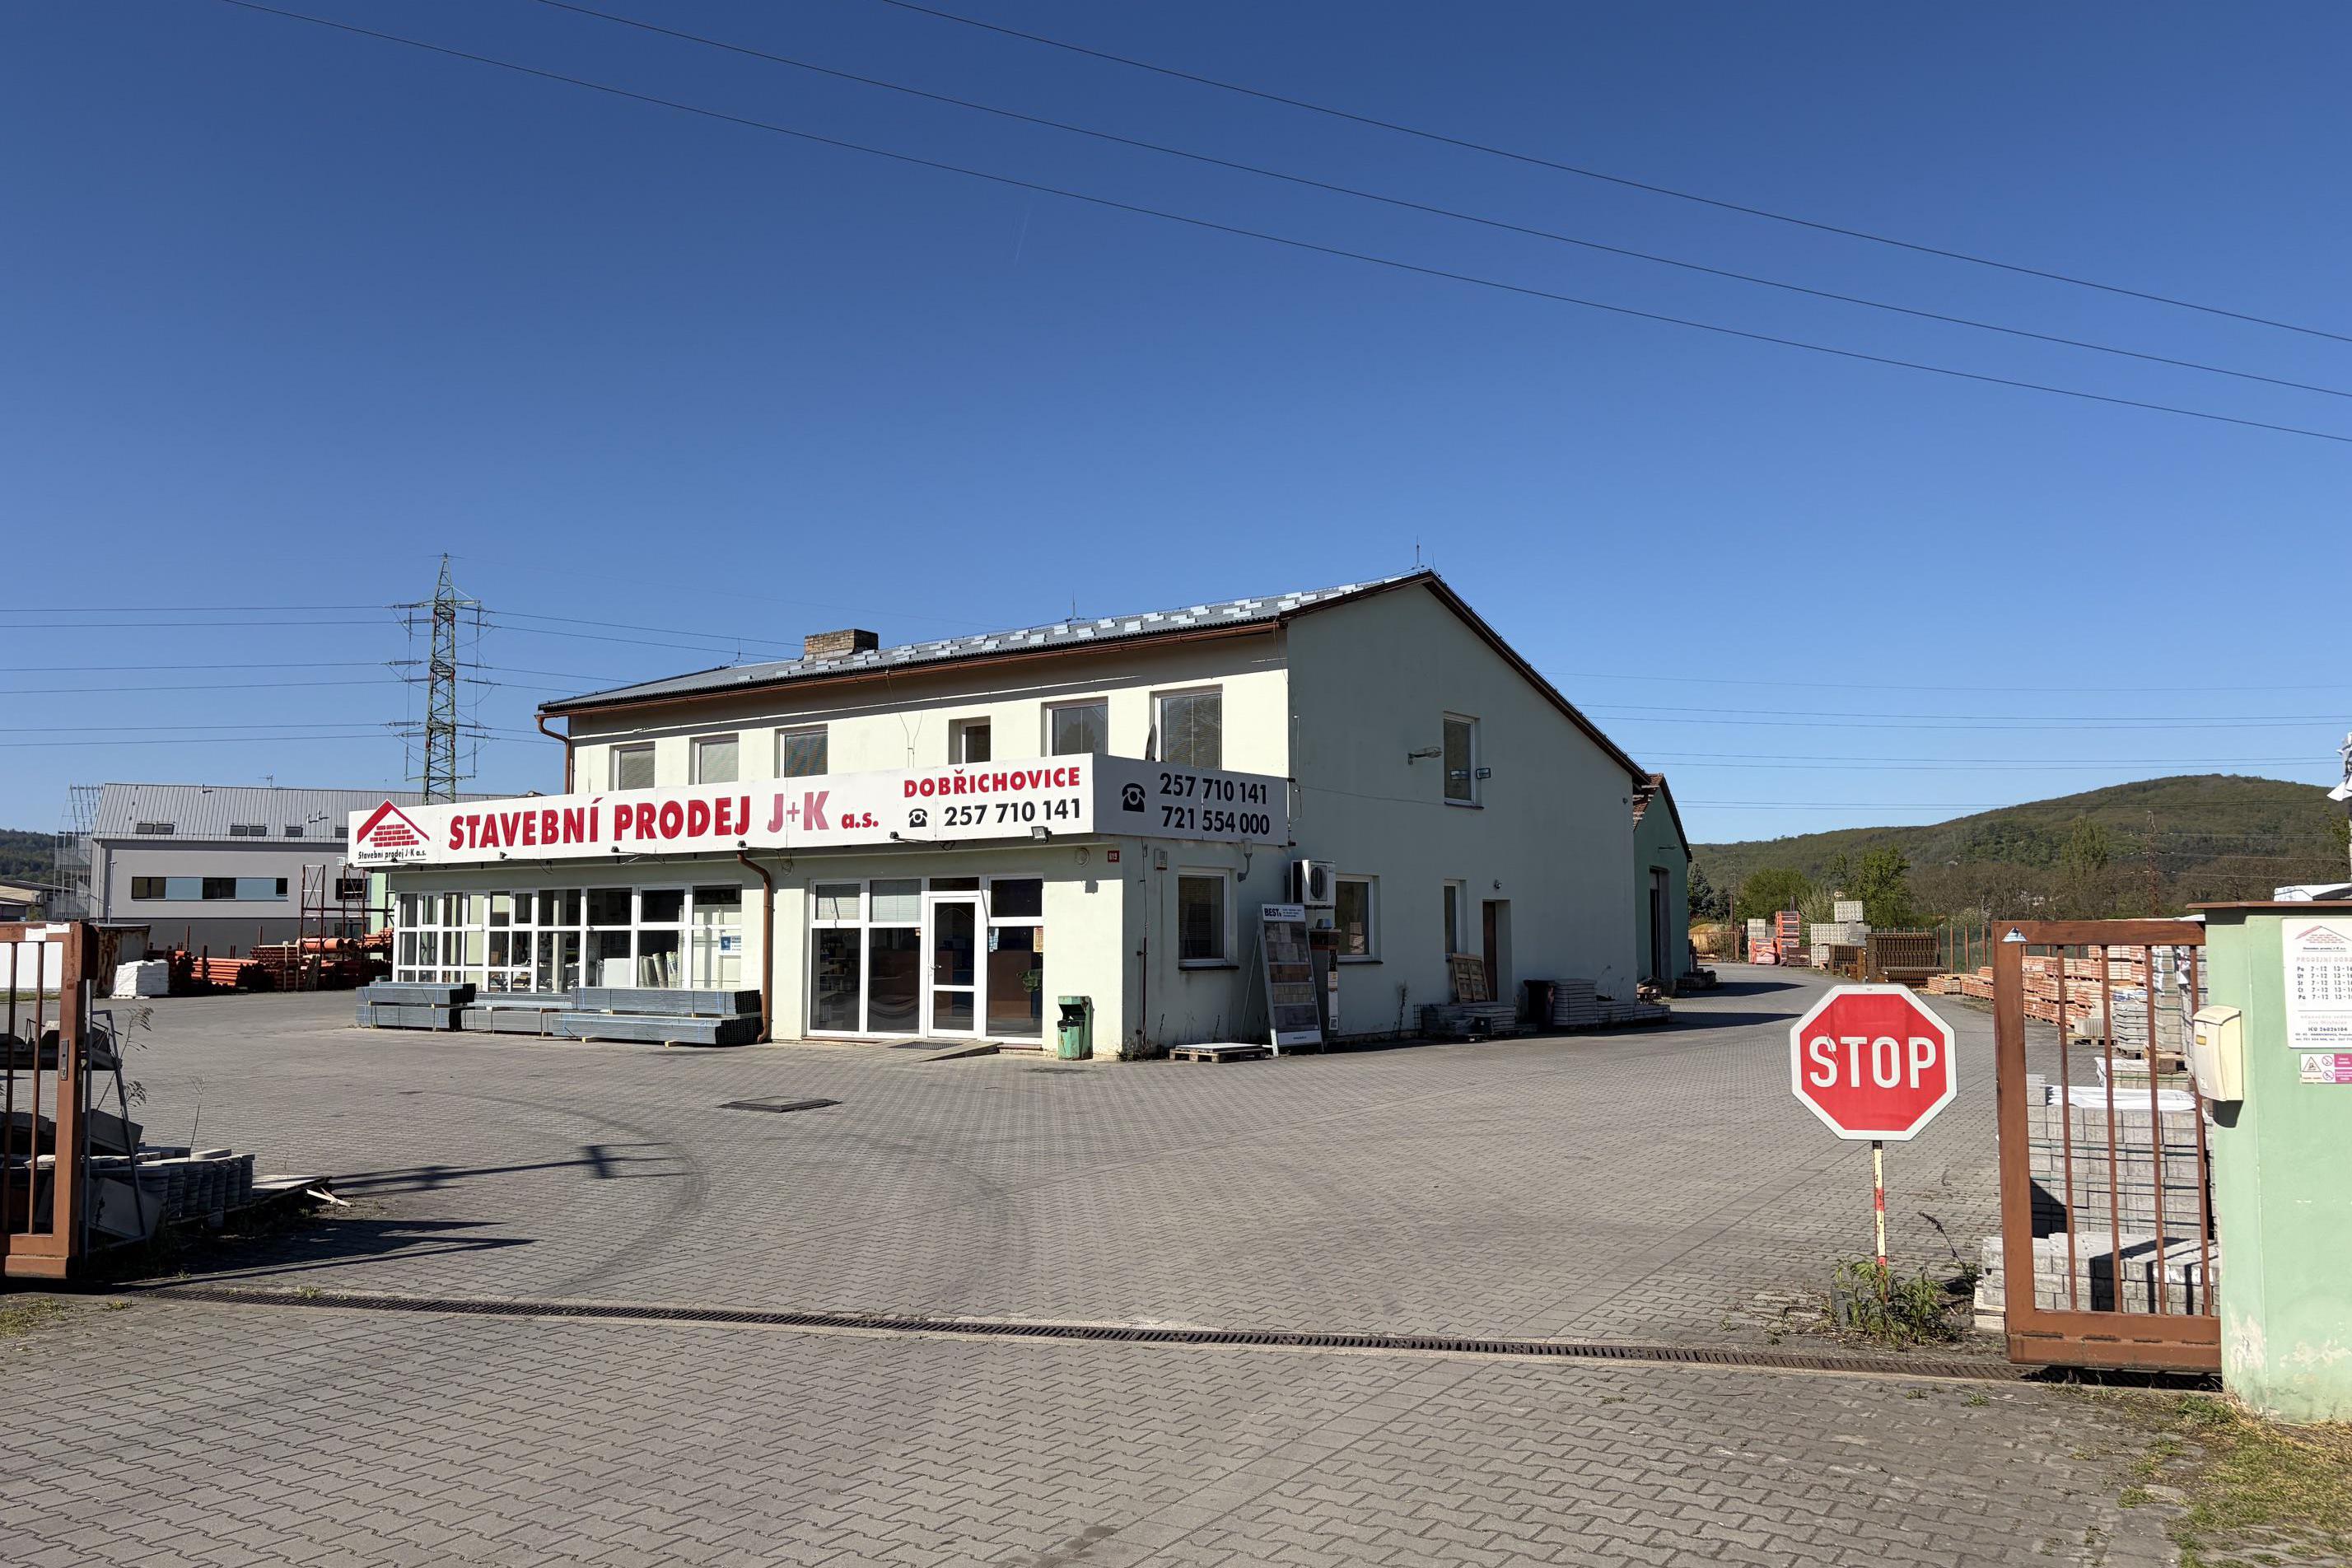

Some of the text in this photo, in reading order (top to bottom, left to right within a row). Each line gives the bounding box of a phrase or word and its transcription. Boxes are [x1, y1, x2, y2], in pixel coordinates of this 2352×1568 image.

[903, 767, 1080, 798] DOBŘICHOVICE
[1160, 772, 1267, 805] 257 710 141
[448, 791, 879, 851] STAVEBNÍ PRODEJ J+K a.s.
[944, 797, 1080, 827] 257 710 141
[1161, 805, 1270, 836] 721 554 000
[385, 848, 404, 860] prodej
[1808, 1035, 1937, 1089] STOP
